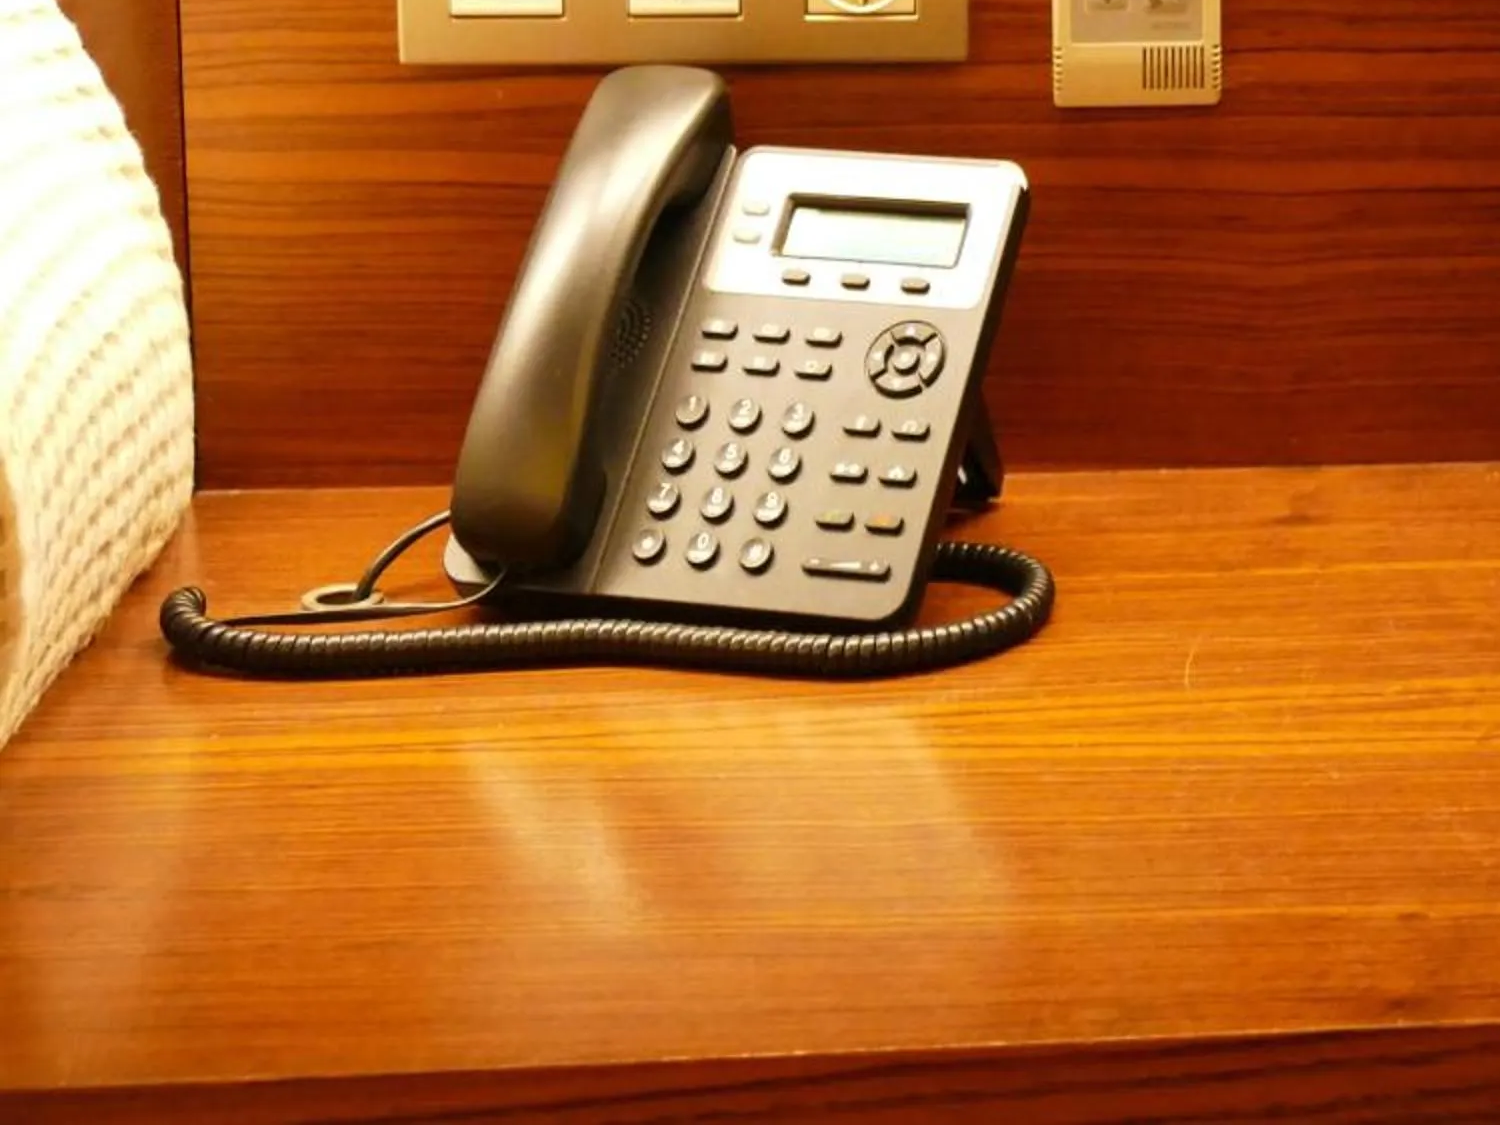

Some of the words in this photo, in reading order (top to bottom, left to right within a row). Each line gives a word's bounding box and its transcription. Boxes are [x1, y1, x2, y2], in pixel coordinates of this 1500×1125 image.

[689, 395, 697, 410] 1
[740, 399, 752, 414] 2
[793, 403, 803, 417] 3
[673, 439, 684, 454] 4
[726, 443, 738, 458] 5
[779, 447, 790, 462] 6
[660, 483, 671, 498] 7
[712, 487, 723, 503] 8
[766, 491, 778, 506] 9
[698, 532, 709, 547] 0
